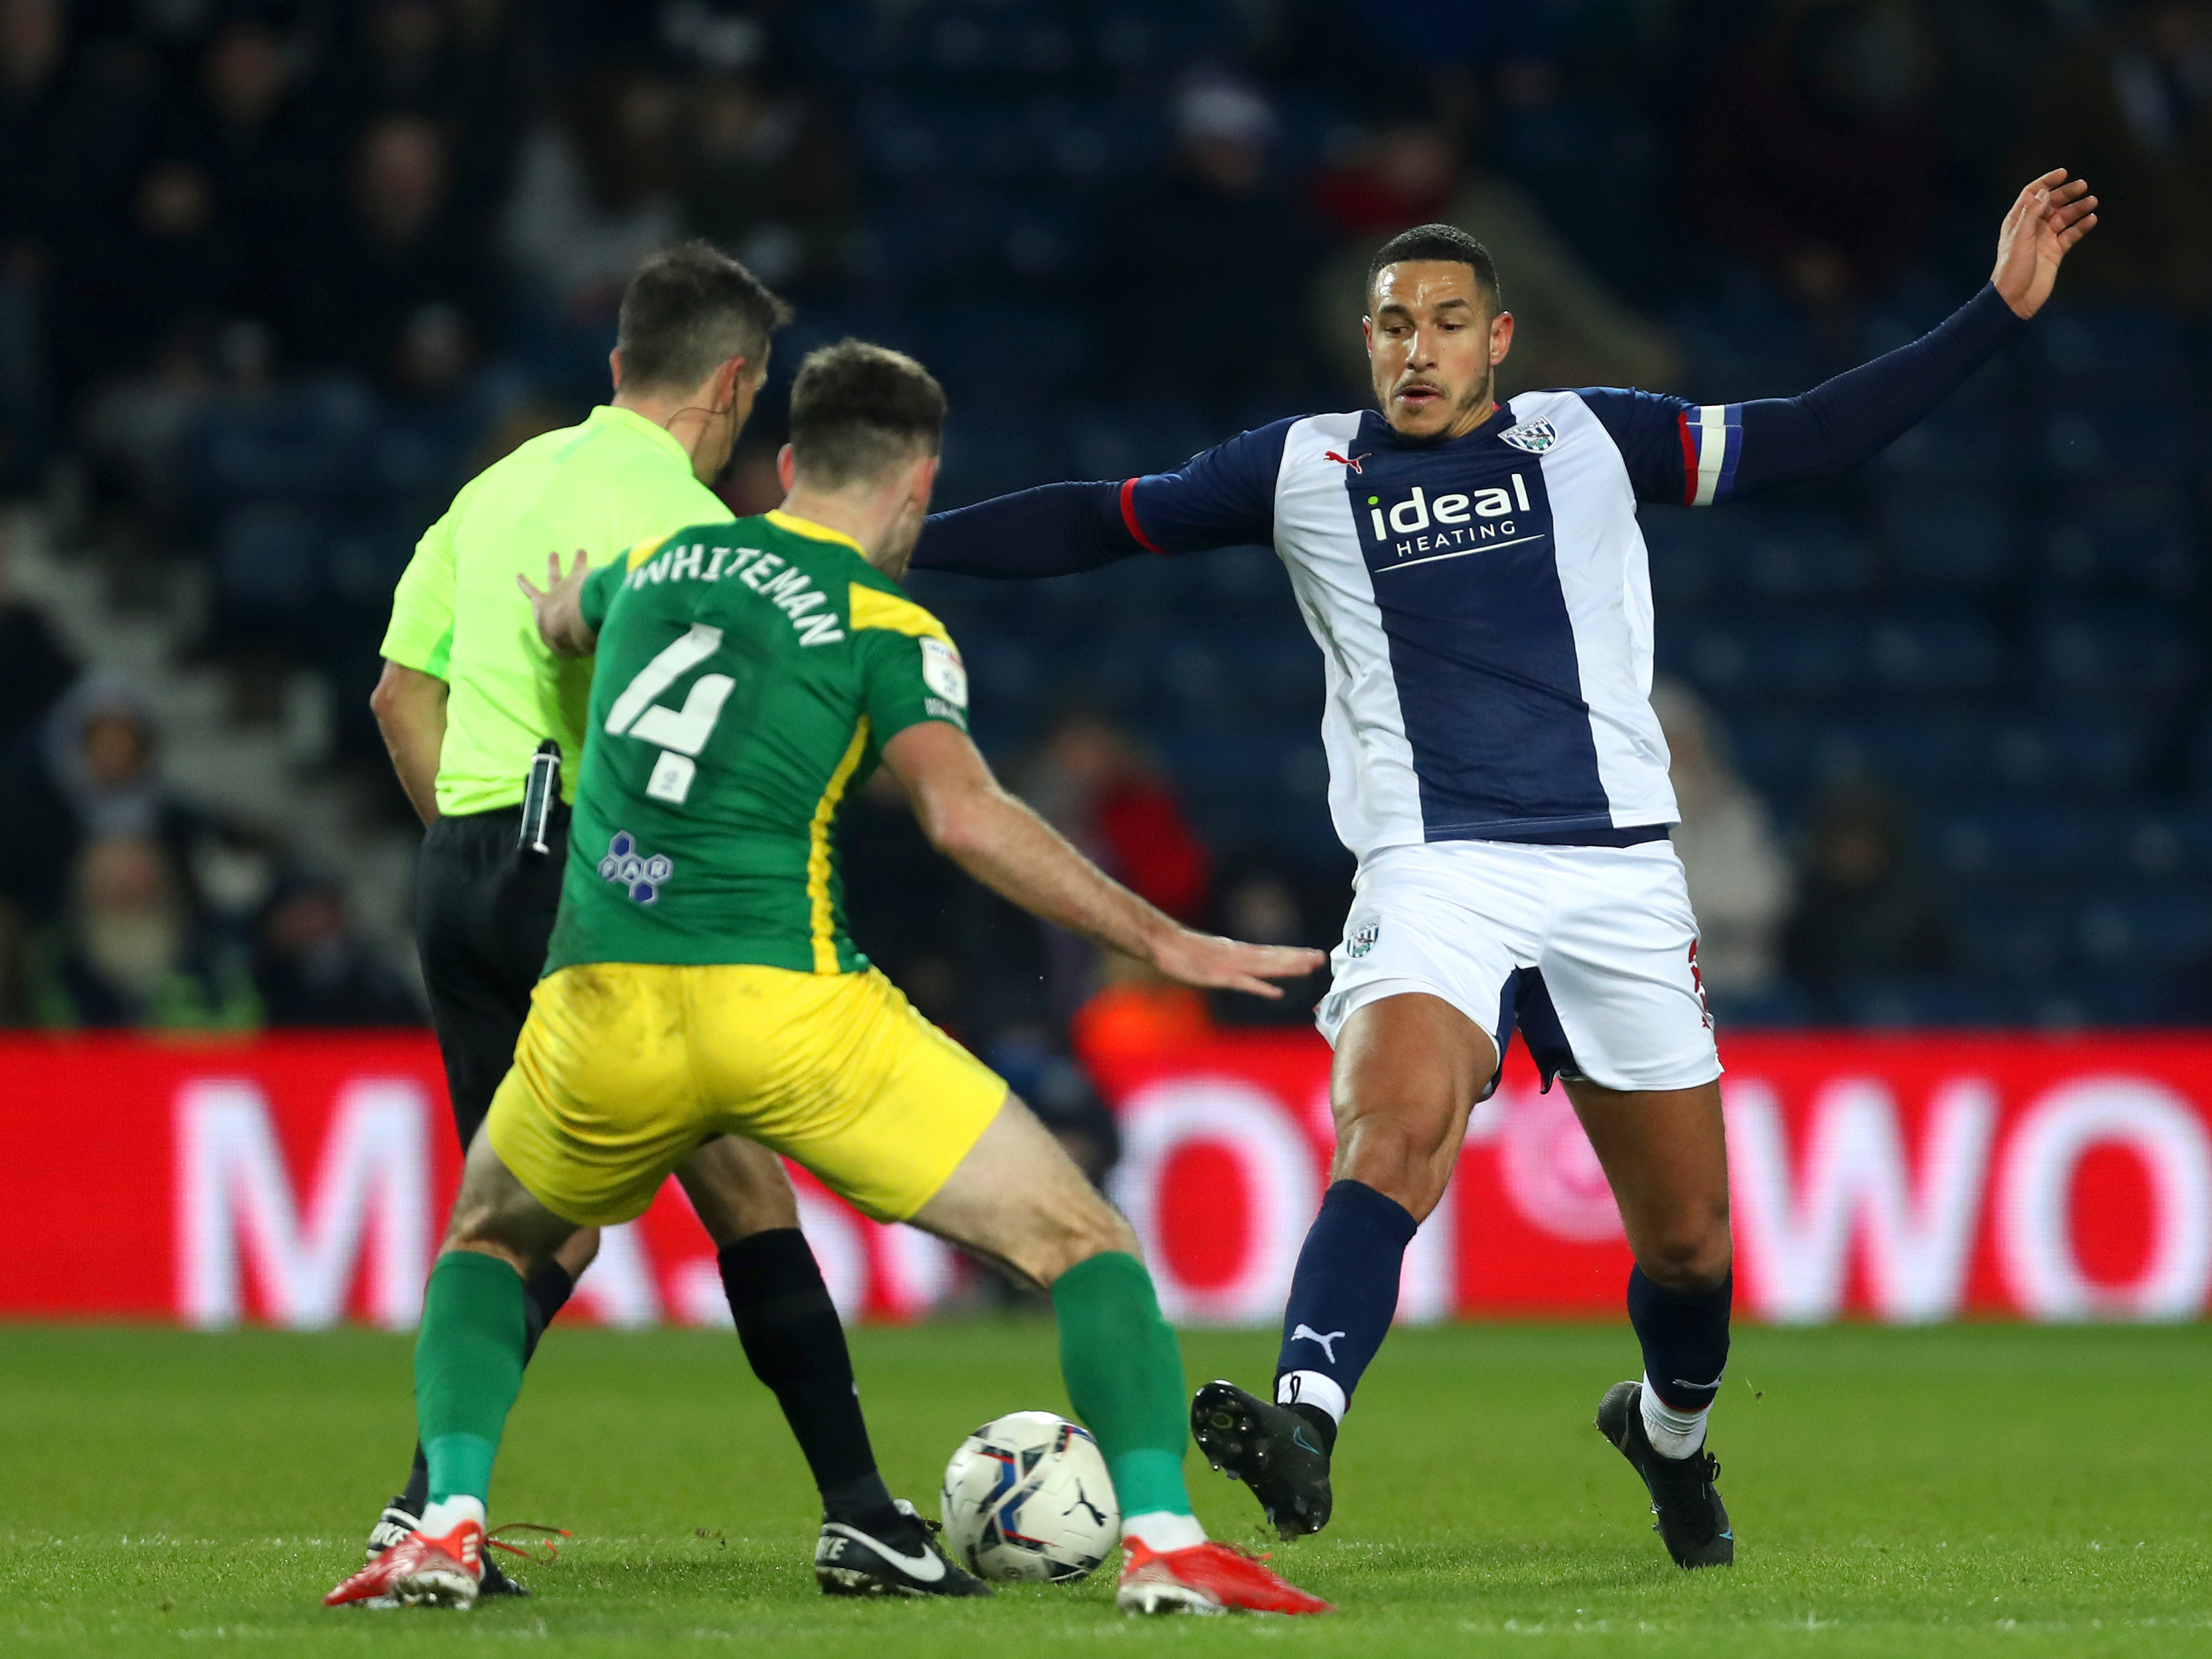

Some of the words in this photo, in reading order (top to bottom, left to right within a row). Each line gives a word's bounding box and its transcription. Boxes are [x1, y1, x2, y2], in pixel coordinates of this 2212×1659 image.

[1367, 473, 1530, 541] ideal
[1396, 520, 1516, 557] HEATING
[622, 543, 846, 647] WHITEMAN
[604, 621, 736, 805] 4
